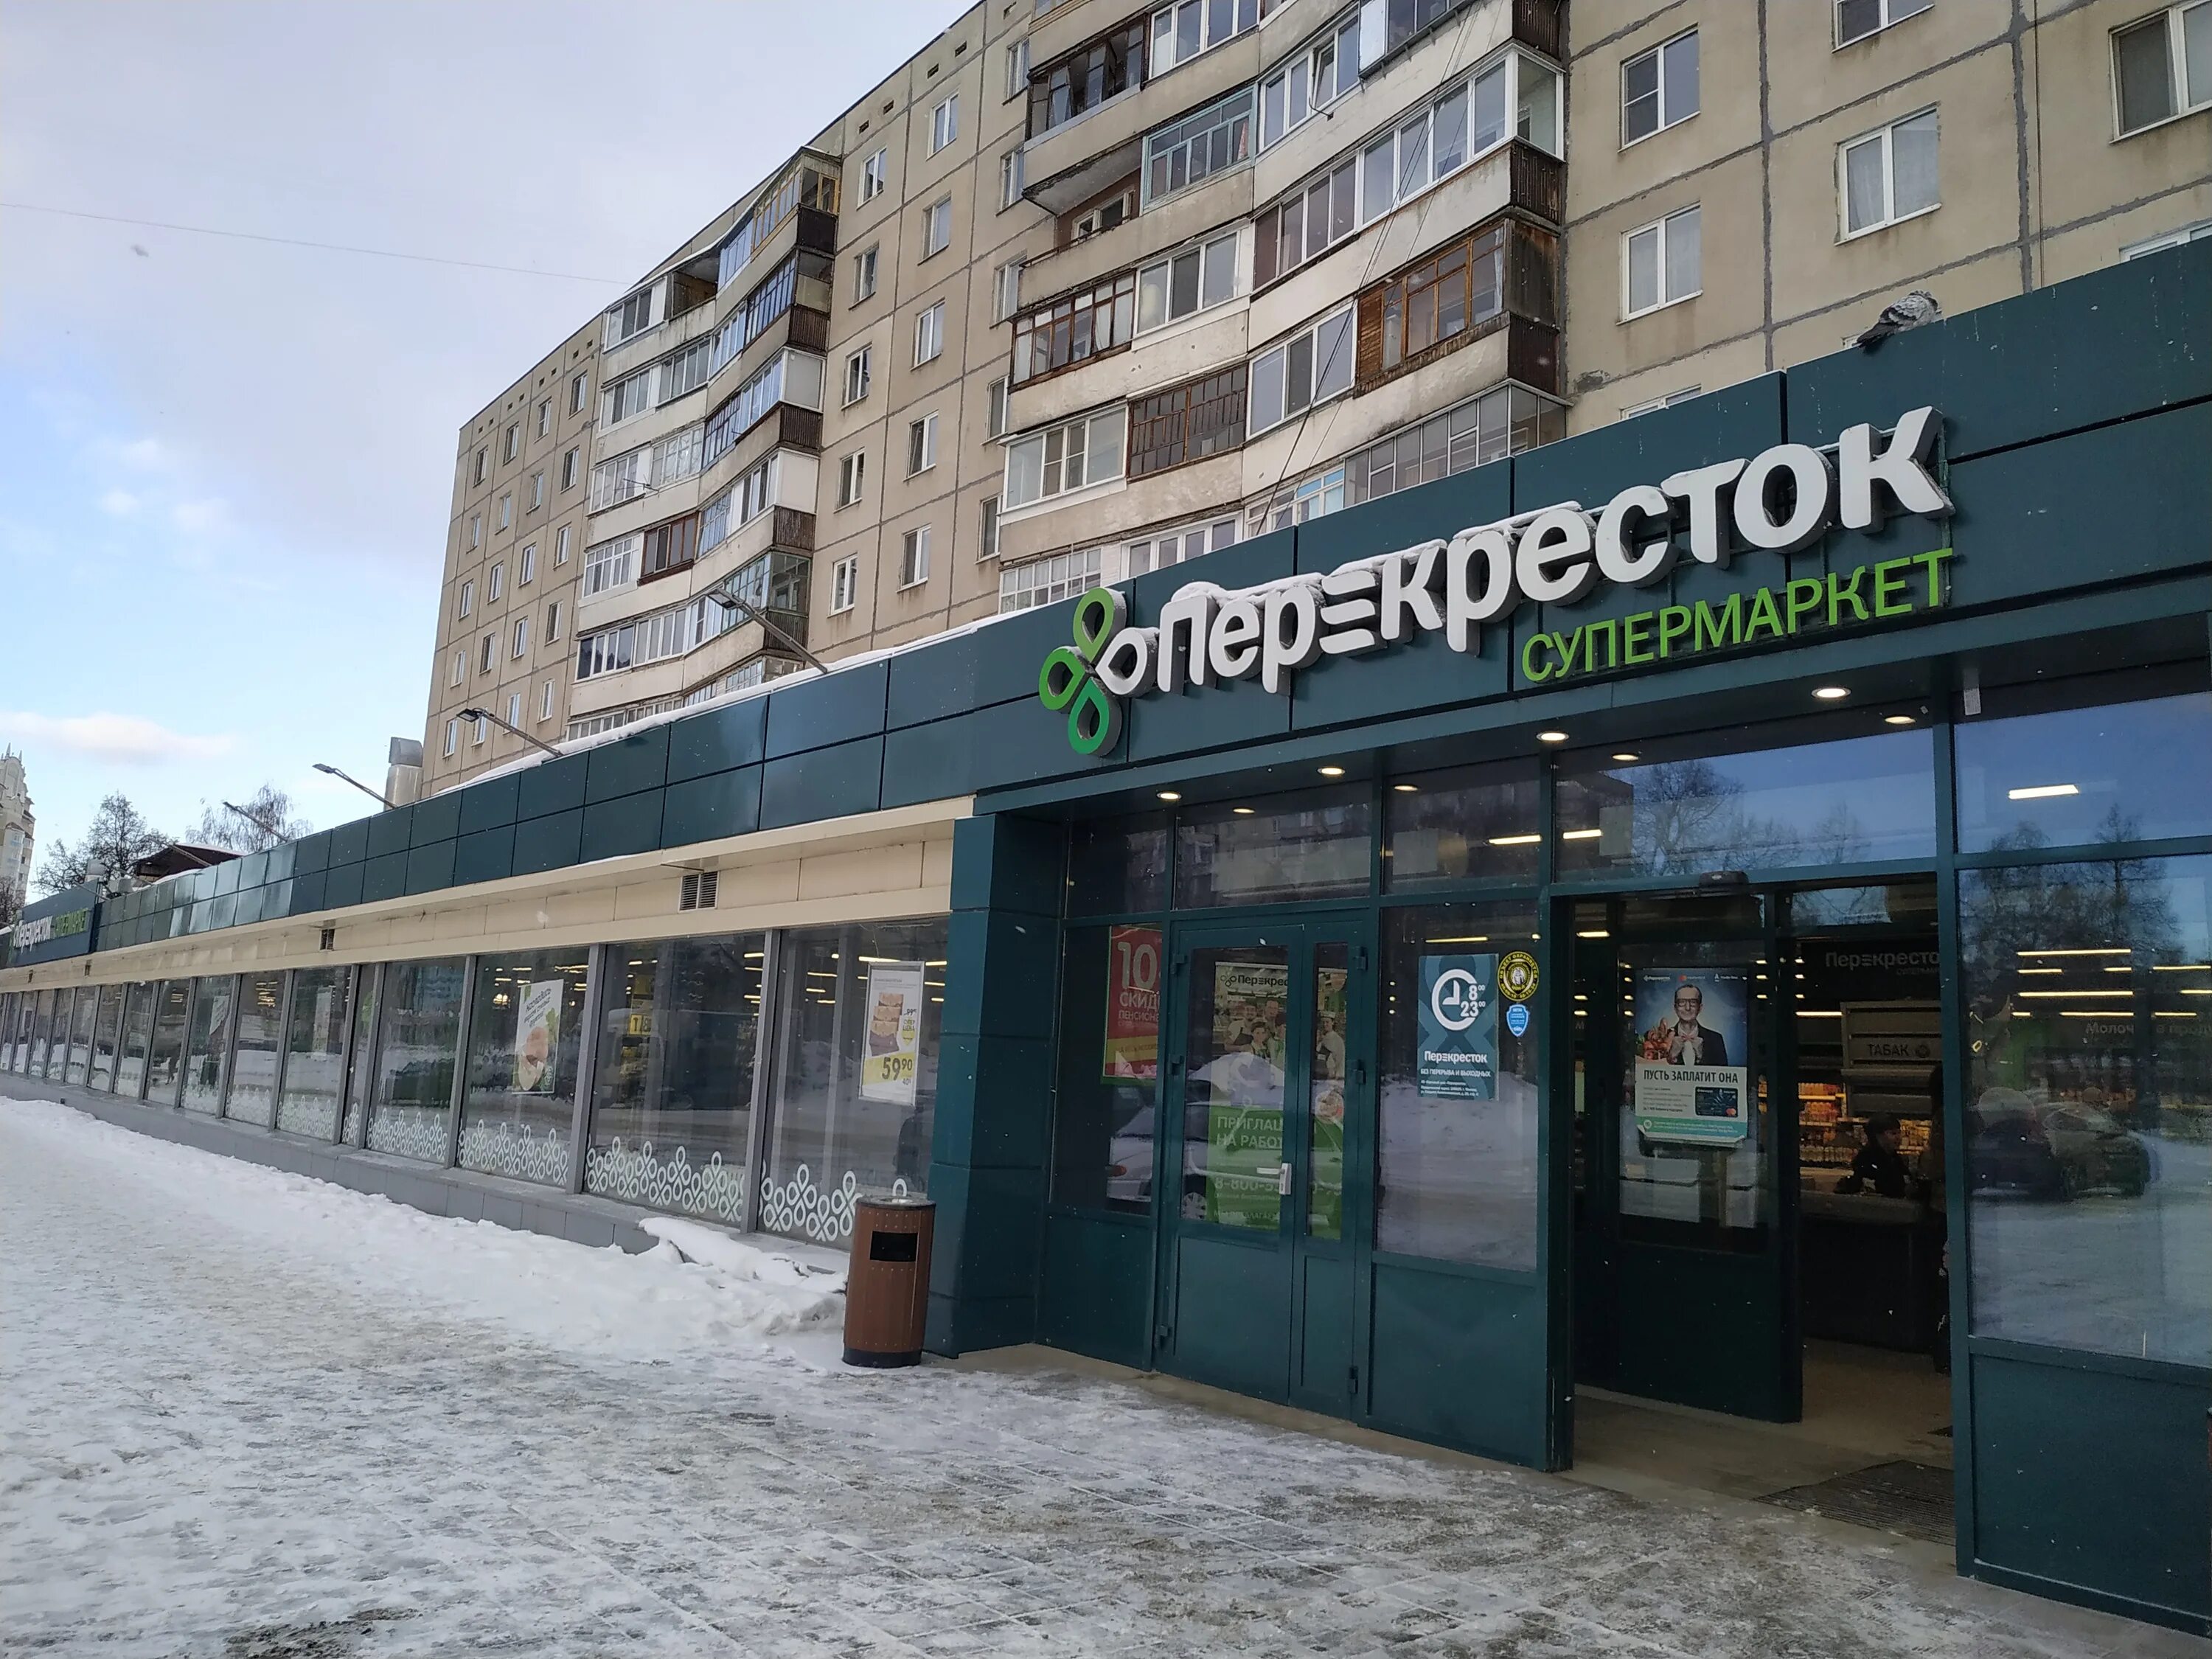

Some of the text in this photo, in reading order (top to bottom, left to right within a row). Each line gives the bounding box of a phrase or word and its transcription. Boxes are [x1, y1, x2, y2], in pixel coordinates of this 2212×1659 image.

[1156, 406, 1952, 694] Перекресток
[1520, 547, 1952, 683] СУПЕРМАРКЕТ
[1825, 951, 1939, 971] Перекресто
[1237, 974, 1288, 987] Перекрес
[1118, 1010, 1159, 1023] ПЕНСИОНЕ
[1424, 1051, 1487, 1064] Перекресток
[1867, 1044, 1909, 1057] ТАБАК
[1644, 1070, 1739, 1084] ПУСТЬ ЗАПЛАТИТ ОНА
[1217, 1116, 1282, 1131] ПРИГЛАШ
[1216, 1133, 1282, 1149] НА РАБОТ
